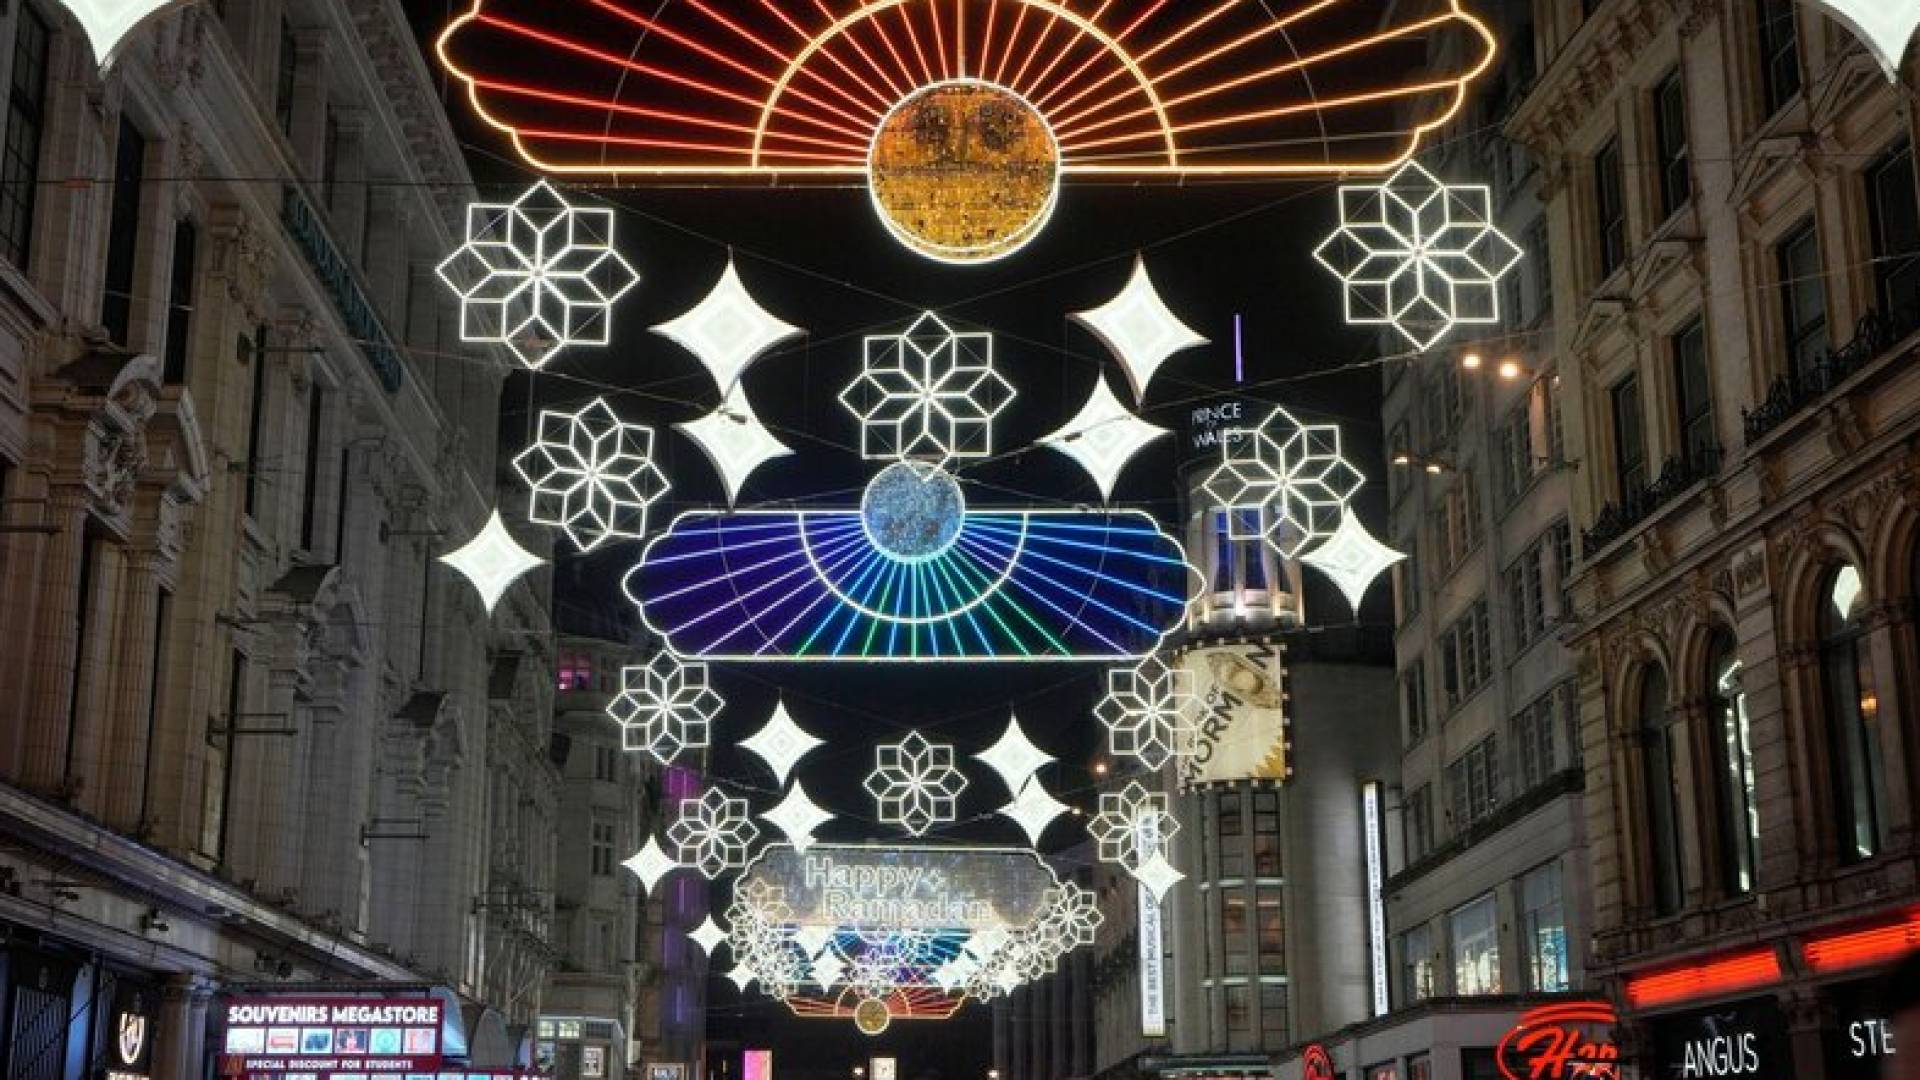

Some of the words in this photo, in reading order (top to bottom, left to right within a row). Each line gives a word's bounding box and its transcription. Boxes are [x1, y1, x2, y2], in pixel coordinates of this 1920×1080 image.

[805, 856, 924, 898] Happy
[822, 887, 995, 922] Ramadan
[229, 1006, 328, 1023] SOUVENIRS
[332, 1006, 438, 1023] MEGASTORE
[1683, 1032, 1760, 1079] ANGUS
[1849, 1018, 1896, 1057] STE
[246, 1060, 286, 1069] SPECIAL
[288, 1060, 338, 1069] DISCOUNT
[342, 1060, 360, 1069] FOR
[365, 1060, 413, 1069] STUDENTS
